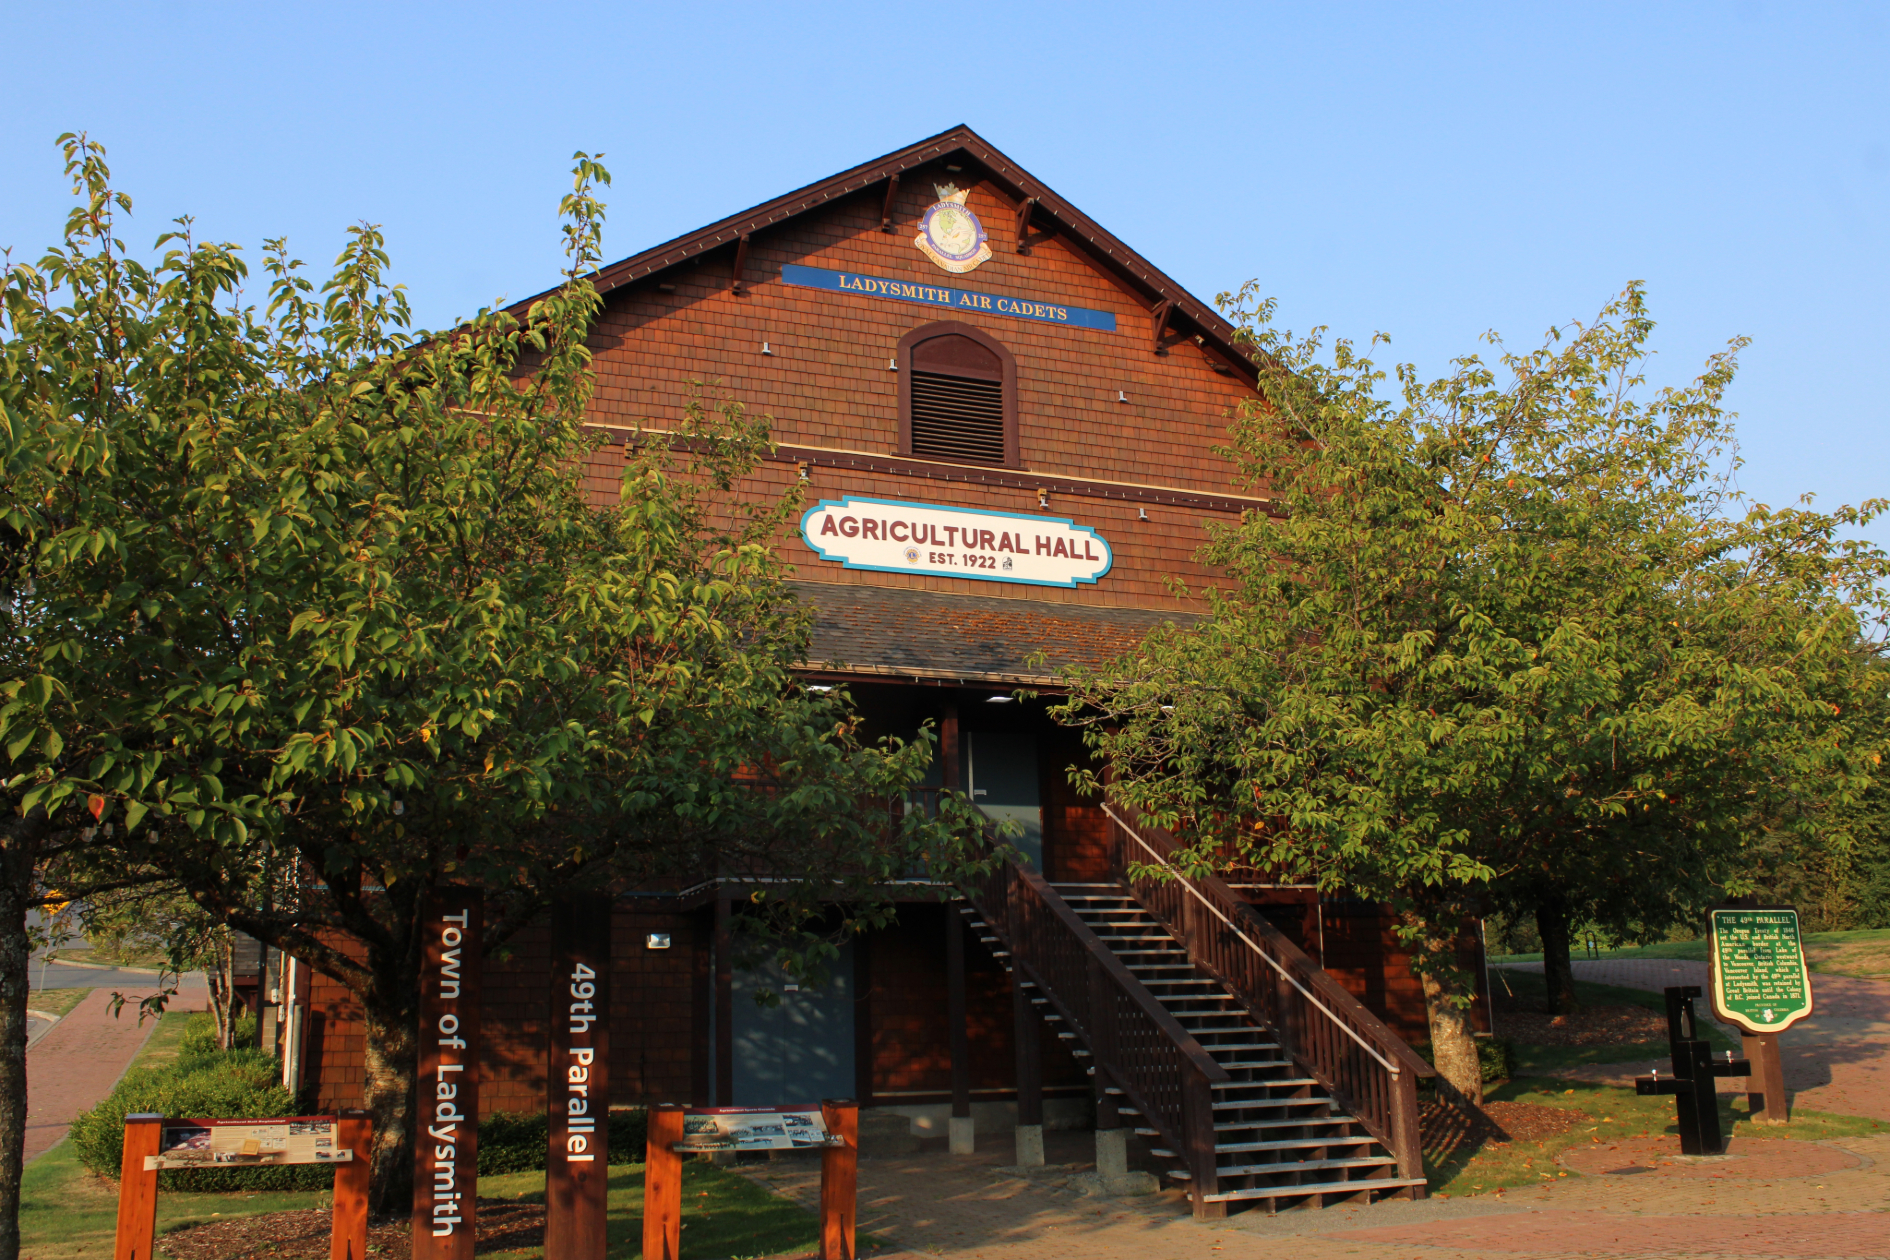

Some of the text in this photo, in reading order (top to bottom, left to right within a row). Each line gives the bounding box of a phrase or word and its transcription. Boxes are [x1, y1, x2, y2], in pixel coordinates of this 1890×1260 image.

[933, 202, 971, 216] LADYSMITH
[838, 275, 1068, 321] LADYSMITH AIR CADETS
[820, 514, 1100, 561] AGRICULTURAL HALL
[929, 552, 996, 570] EST. 1922
[1722, 916, 1790, 924] THE 49th PARALLEL
[428, 909, 468, 1237] Town of Ladysmith
[567, 963, 597, 1162] 49th Parallel
